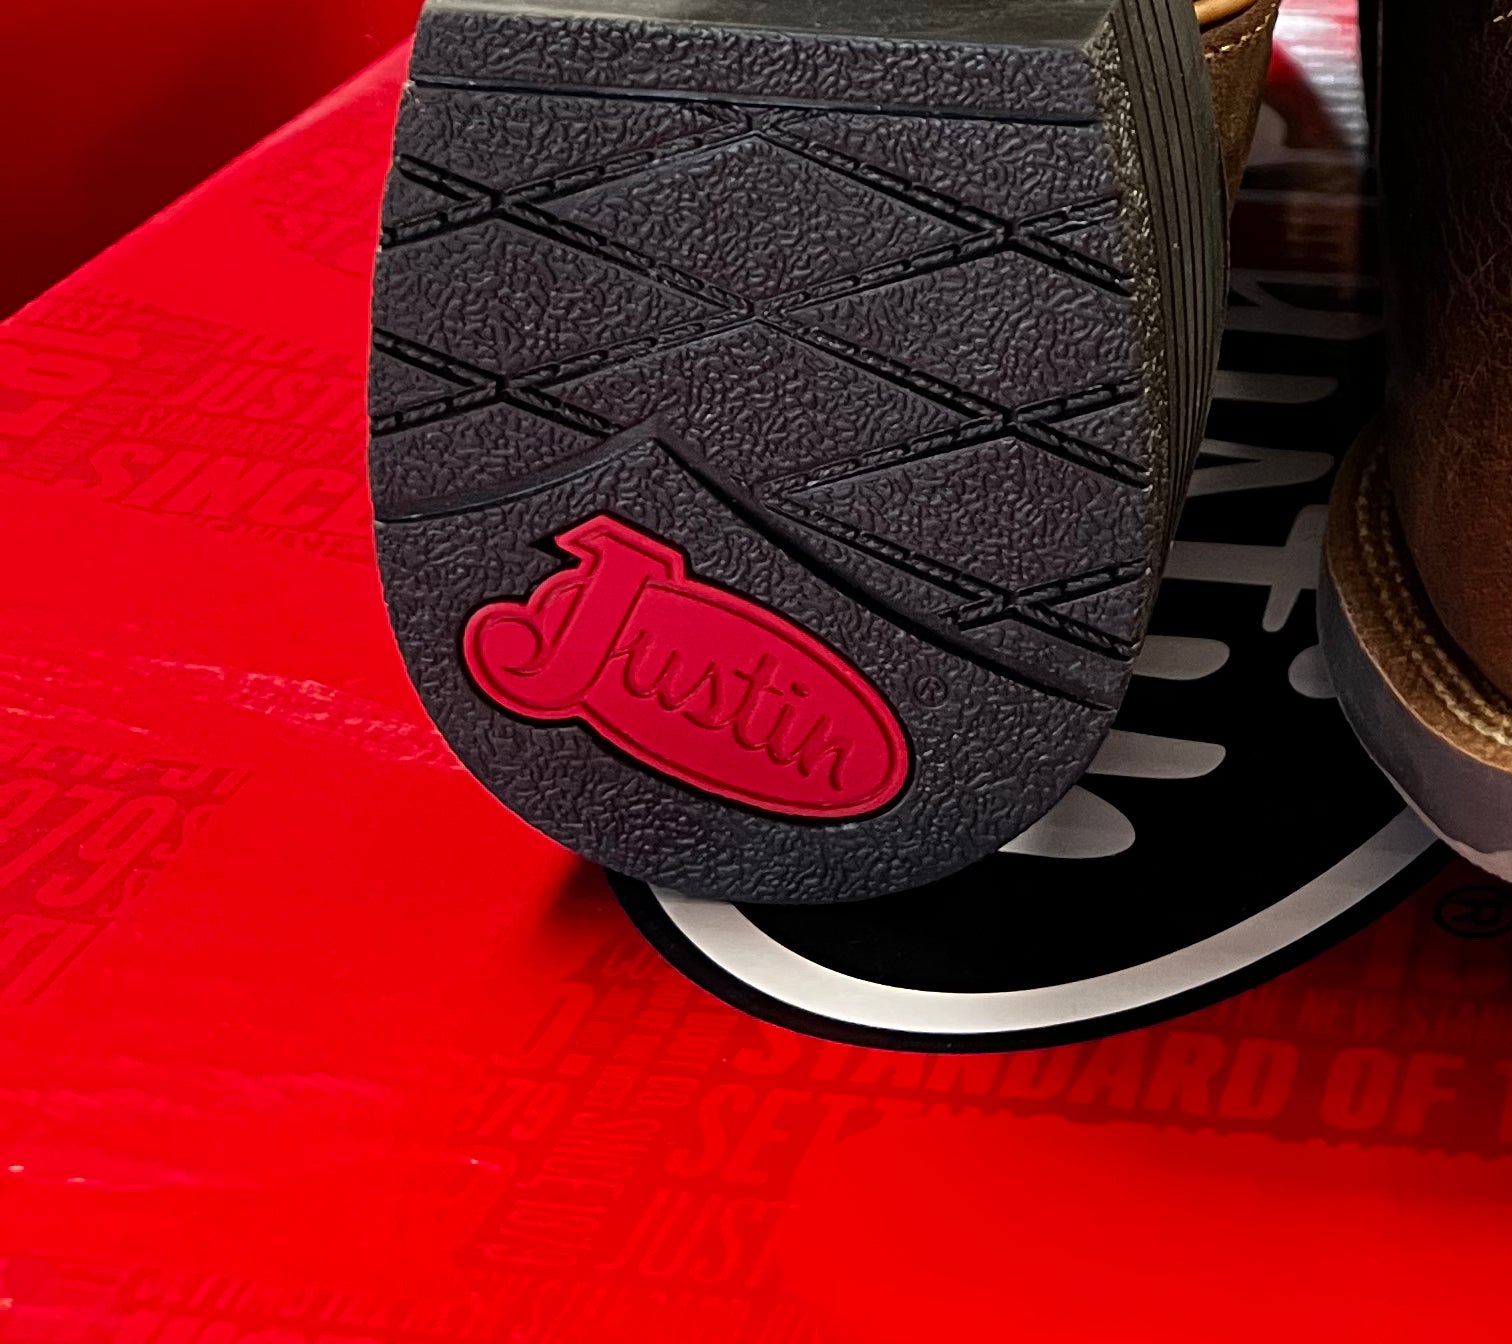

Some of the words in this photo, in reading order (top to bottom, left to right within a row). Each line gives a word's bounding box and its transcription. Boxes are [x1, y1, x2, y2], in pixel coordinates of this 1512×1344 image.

[157, 362, 367, 430] JUSTI
[470, 517, 855, 792] Justin
[1320, 1045, 1466, 1136] OF
